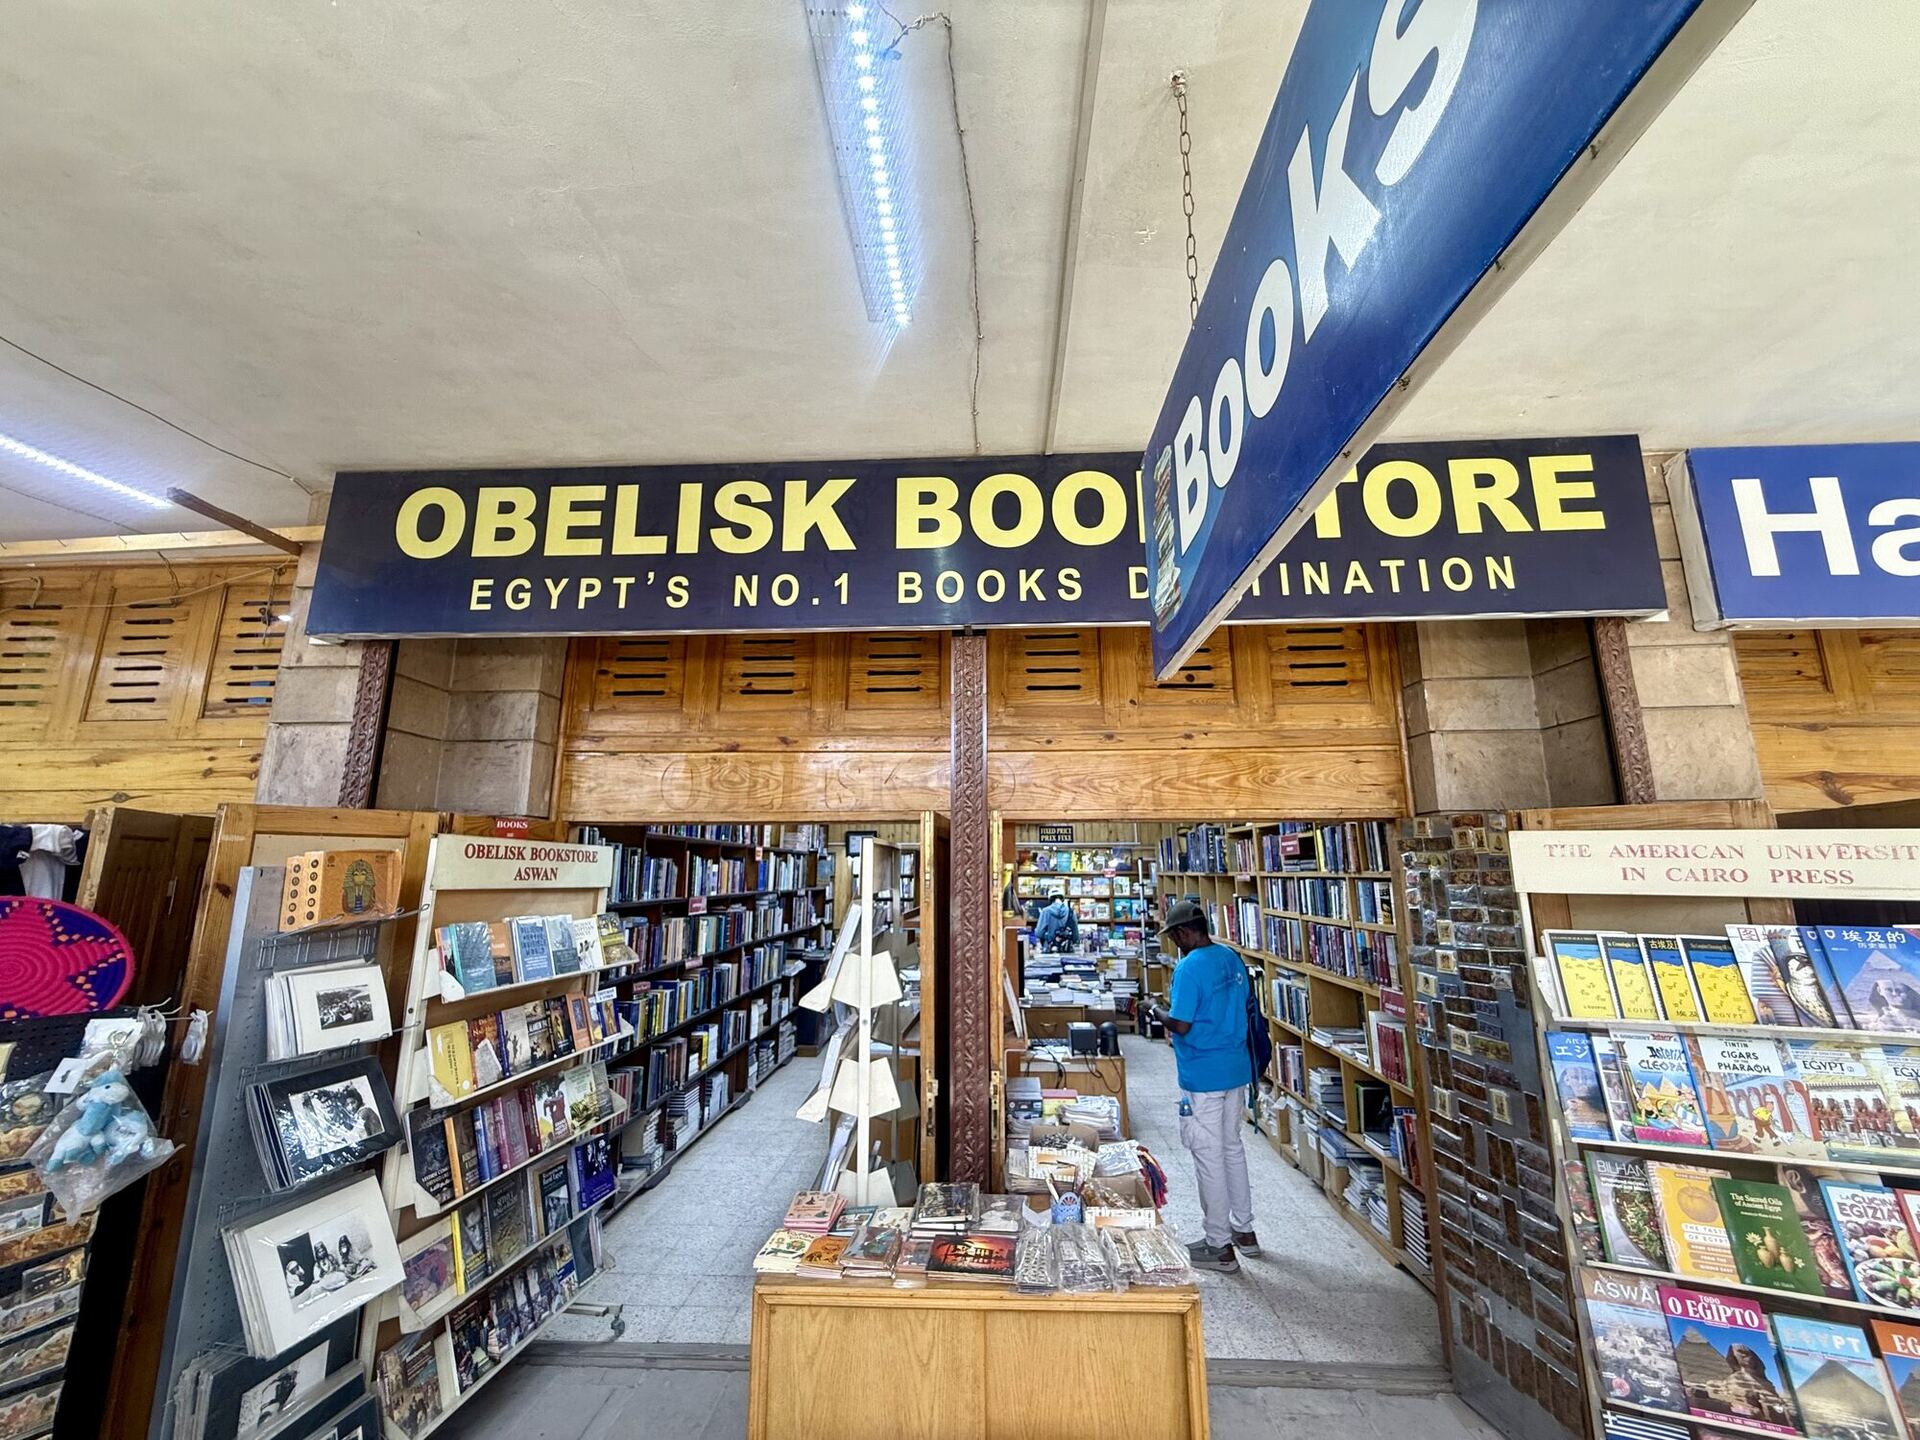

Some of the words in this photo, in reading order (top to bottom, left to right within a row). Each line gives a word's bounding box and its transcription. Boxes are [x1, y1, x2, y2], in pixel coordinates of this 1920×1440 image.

[395, 478, 857, 560] OBELISK
[1731, 476, 1920, 577] Ha
[469, 570, 690, 610] EGYPT'S
[733, 571, 850, 608] NO.1
[897, 566, 1083, 604] BOOKS
[496, 820, 528, 829] BOOKS
[464, 843, 527, 861] OBELISK
[530, 847, 599, 863] BOOKSTORE
[1543, 843, 1592, 858] THE
[1608, 844, 1745, 860] AMERICAN
[514, 867, 558, 881] ASWAN
[1621, 866, 1646, 882] IN
[1665, 867, 1749, 883] CAIRO
[1769, 868, 1855, 885] PRESS
[1841, 930, 1906, 943] 埃及的
[1723, 1041, 1749, 1049] TINTIN
[1720, 1050, 1760, 1061] CIGARS
[1717, 1062, 1772, 1074] PHARAOH
[1802, 1060, 1845, 1072] EGYPT
[1699, 1294, 1721, 1305] TODO
[1667, 1297, 1682, 1315] O
[1685, 1298, 1760, 1328] EGIPTO
